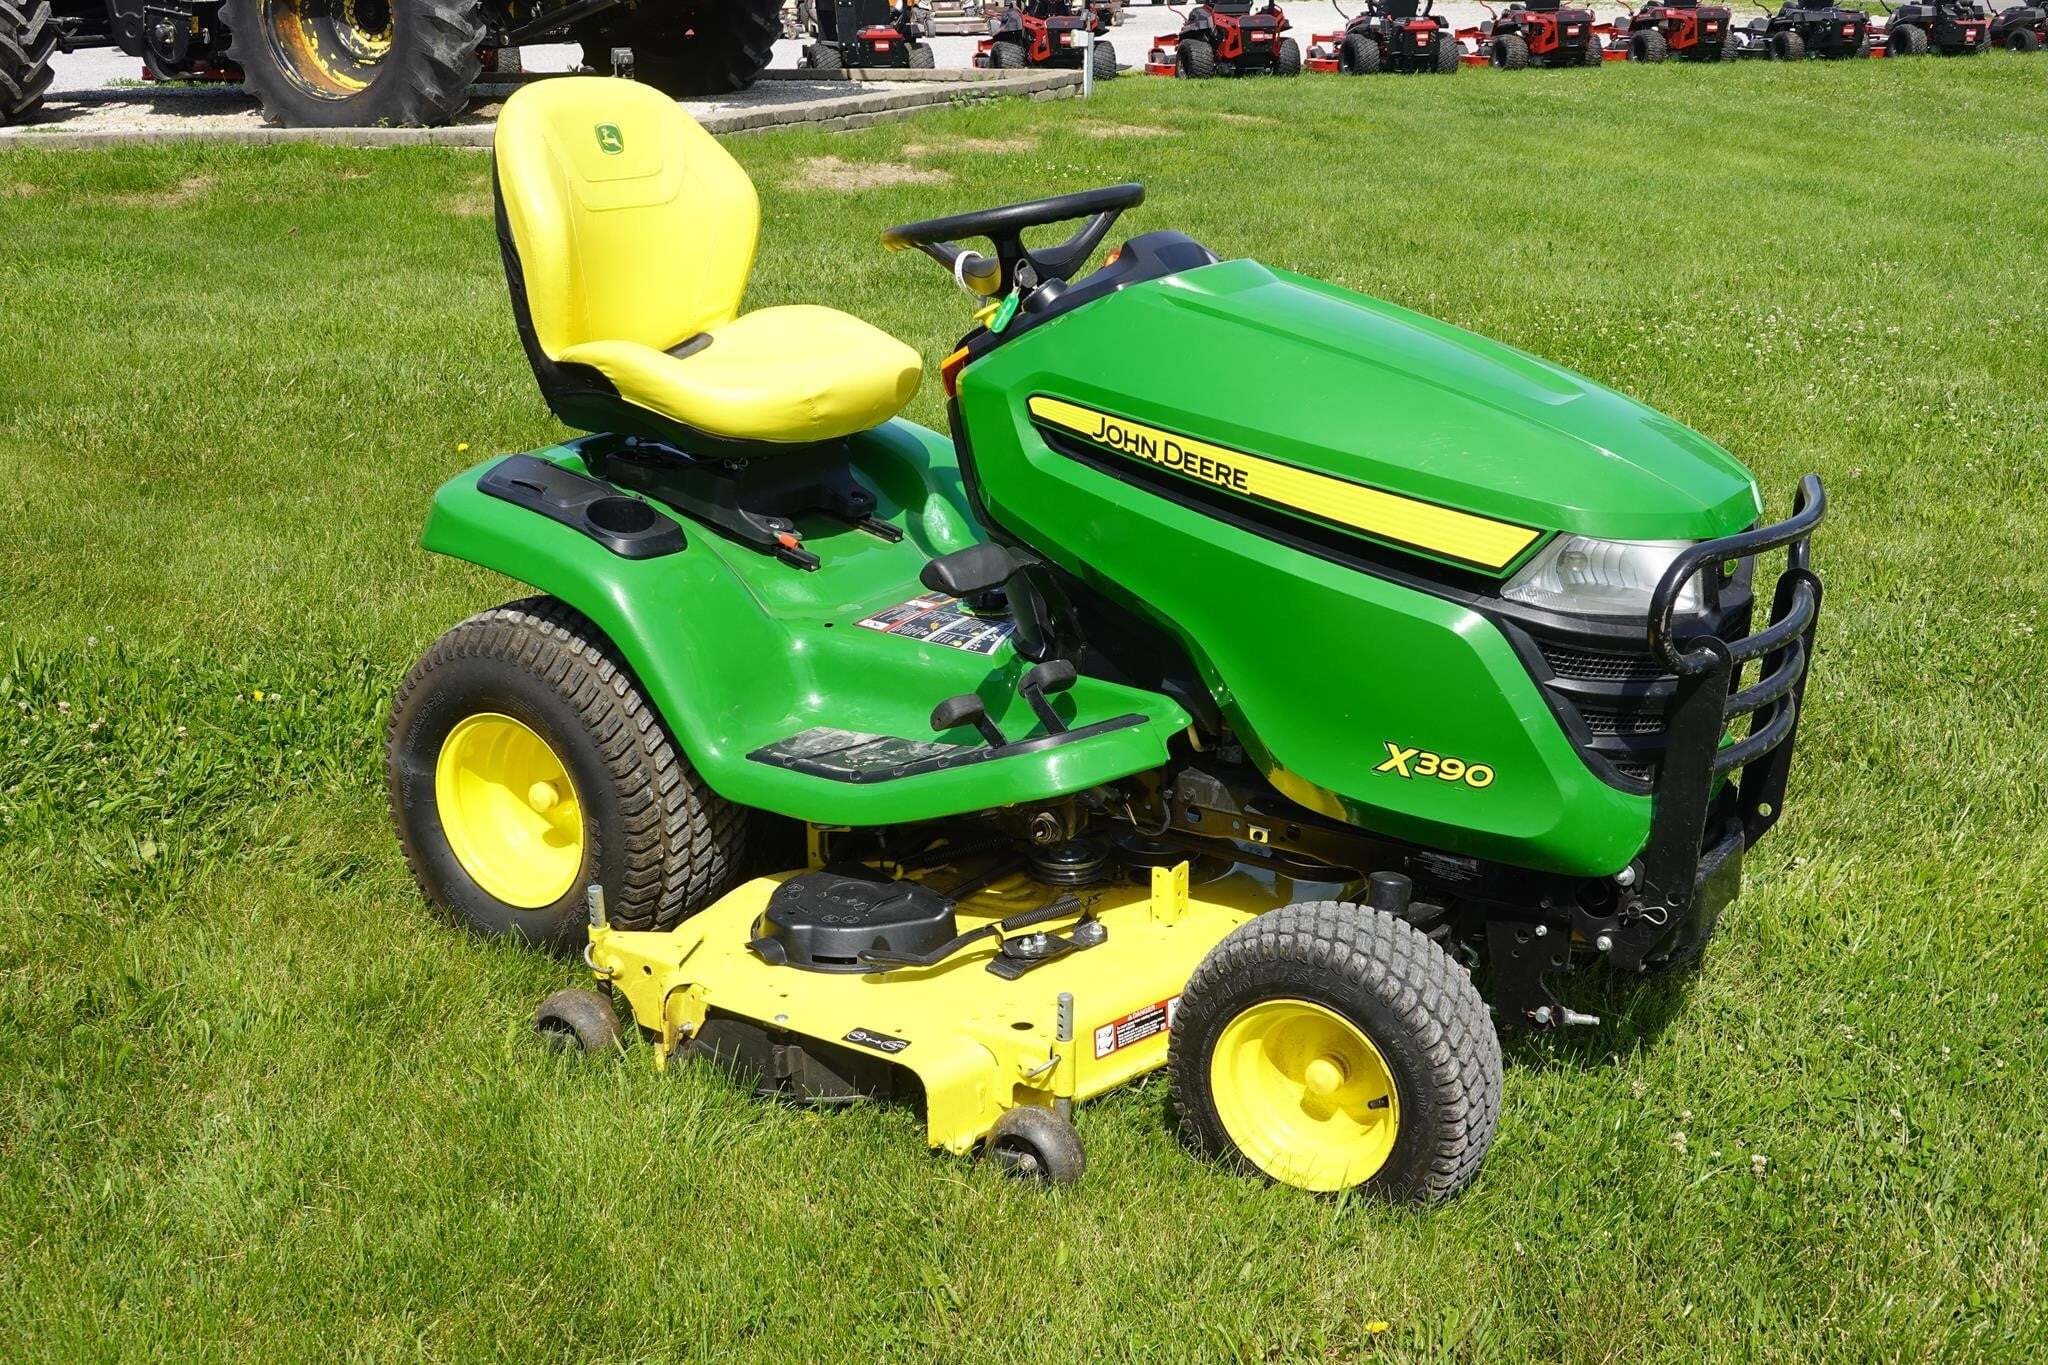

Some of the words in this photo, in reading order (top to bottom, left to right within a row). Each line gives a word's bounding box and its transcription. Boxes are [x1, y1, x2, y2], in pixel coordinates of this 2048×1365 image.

[1092, 417, 1157, 459] JOHN
[1163, 440, 1249, 490] DEERE
[1374, 740, 1496, 788] X390
